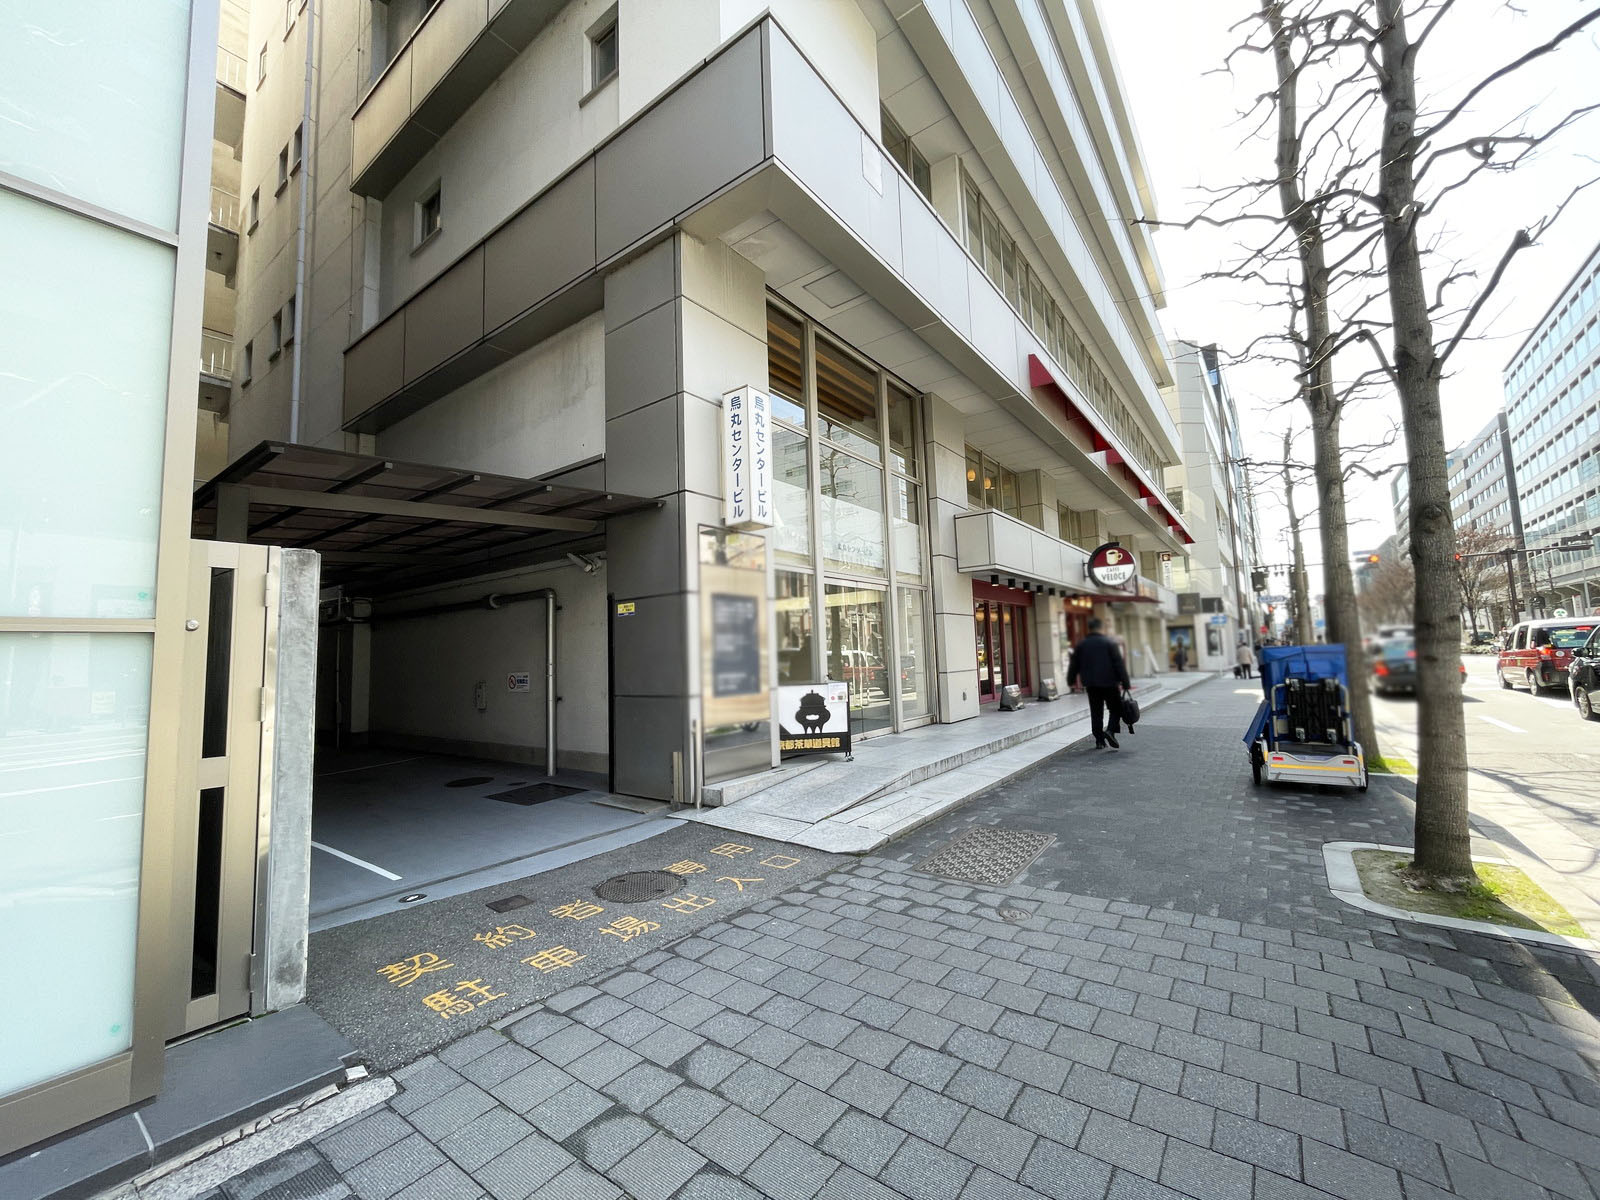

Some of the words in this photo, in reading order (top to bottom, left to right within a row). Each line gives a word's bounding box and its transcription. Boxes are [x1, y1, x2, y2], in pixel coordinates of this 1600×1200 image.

[730, 395, 744, 519] 烏丸センタービル
[754, 395, 767, 518] 烏丸センタービル
[1101, 572, 1126, 581] VELOCE
